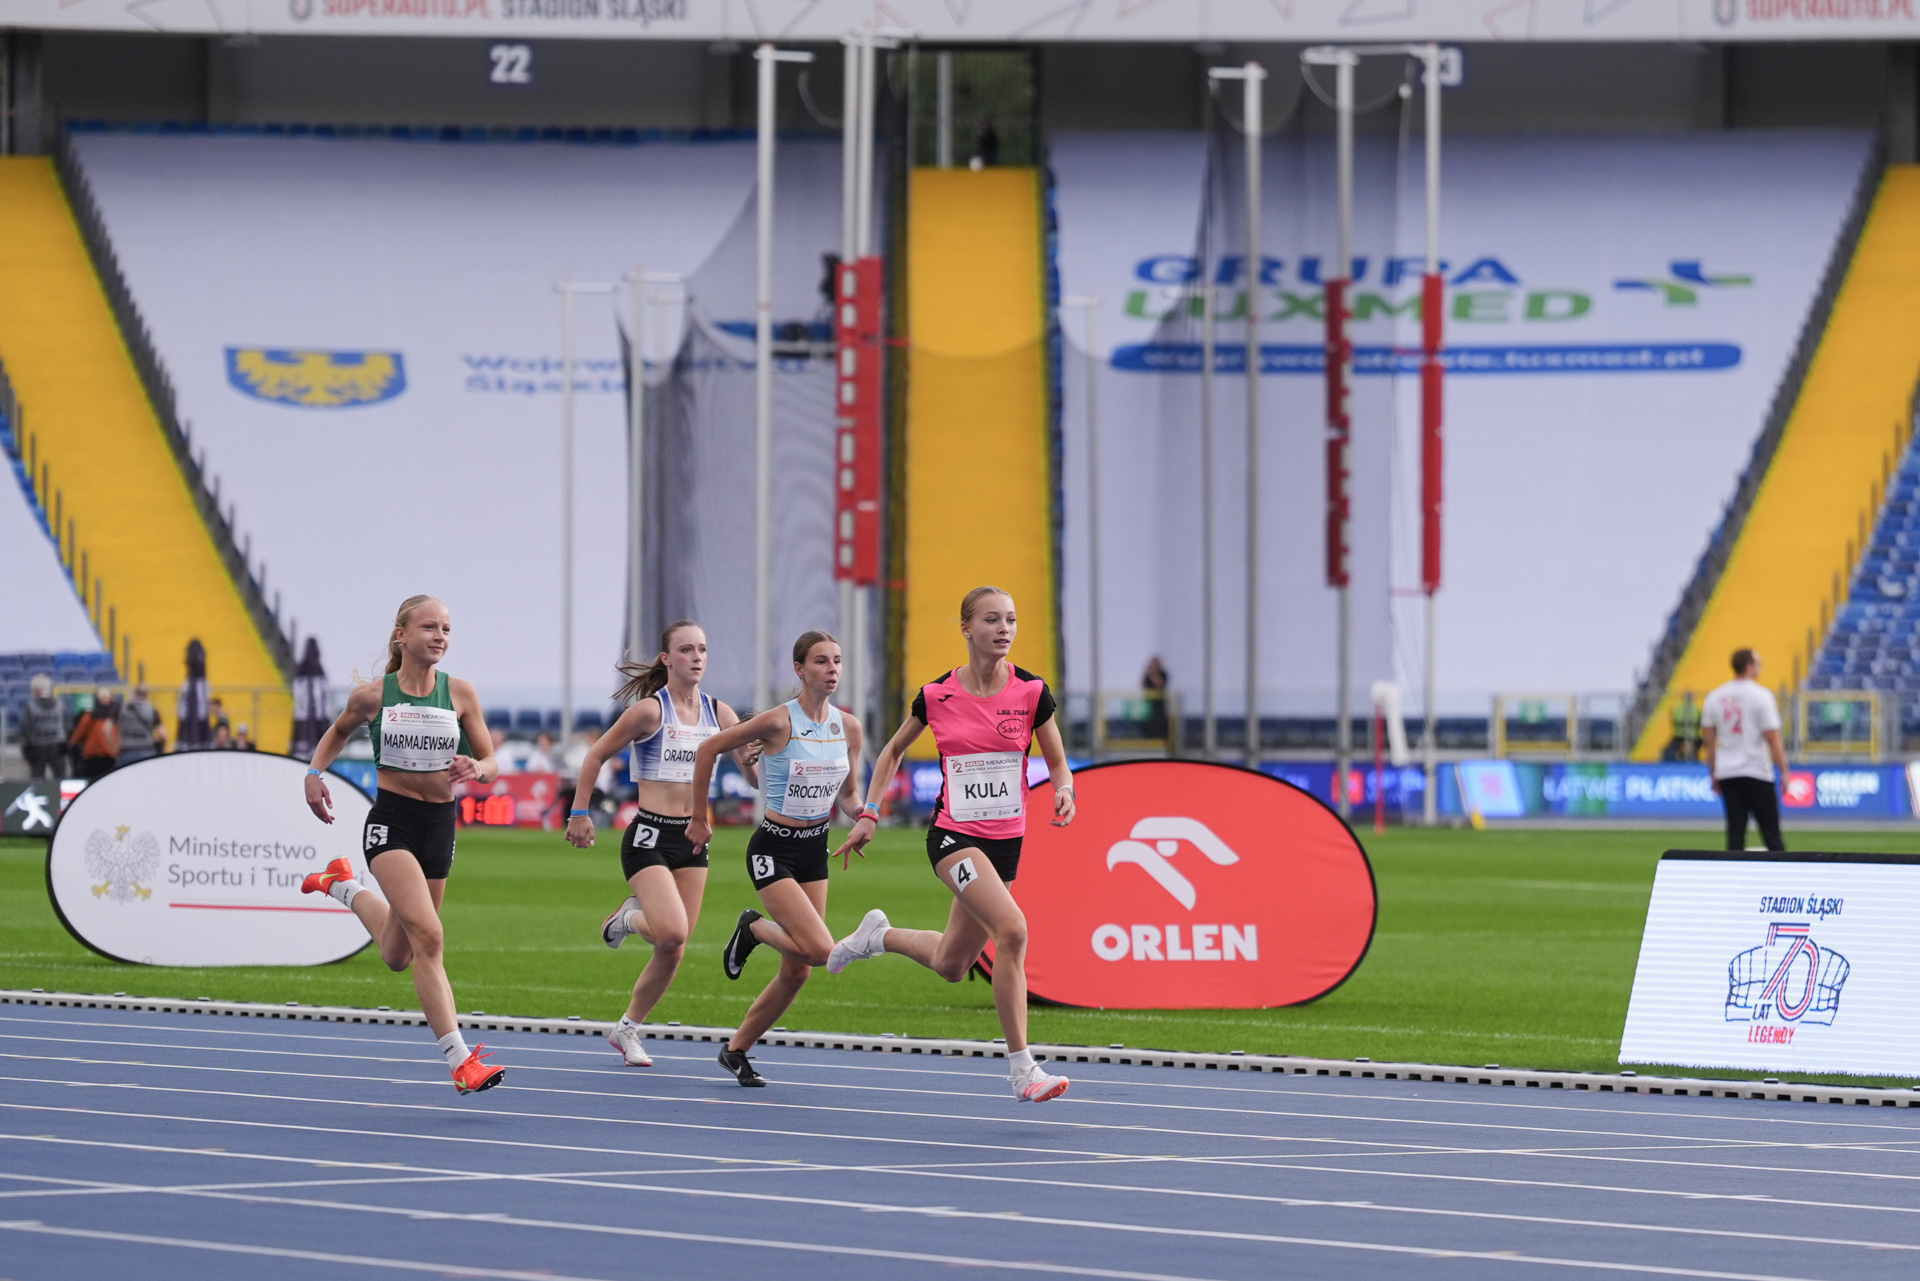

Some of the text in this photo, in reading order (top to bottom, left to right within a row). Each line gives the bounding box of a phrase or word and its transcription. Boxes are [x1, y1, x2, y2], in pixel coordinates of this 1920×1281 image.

[490, 45, 531, 83] 22
[1134, 256, 1520, 286] GRUPA
[1123, 289, 1592, 323] LUXMED
[384, 733, 455, 751] MARMAJEWSKA
[965, 781, 1008, 799] KULA
[369, 826, 381, 847] 5
[637, 827, 653, 847] 2
[762, 820, 791, 837] PRO
[793, 825, 823, 839] NIKE
[169, 836, 317, 860] Ministerstwo
[167, 863, 242, 888] Sportu
[250, 864, 256, 887] i
[756, 855, 769, 876] 3
[958, 862, 971, 884] 4
[1759, 892, 1844, 921] STADION ŚLĄSKI
[1091, 923, 1259, 961] ORLEN
[1752, 1003, 1773, 1020] LAT
[1748, 1025, 1795, 1044] LEGENDY
